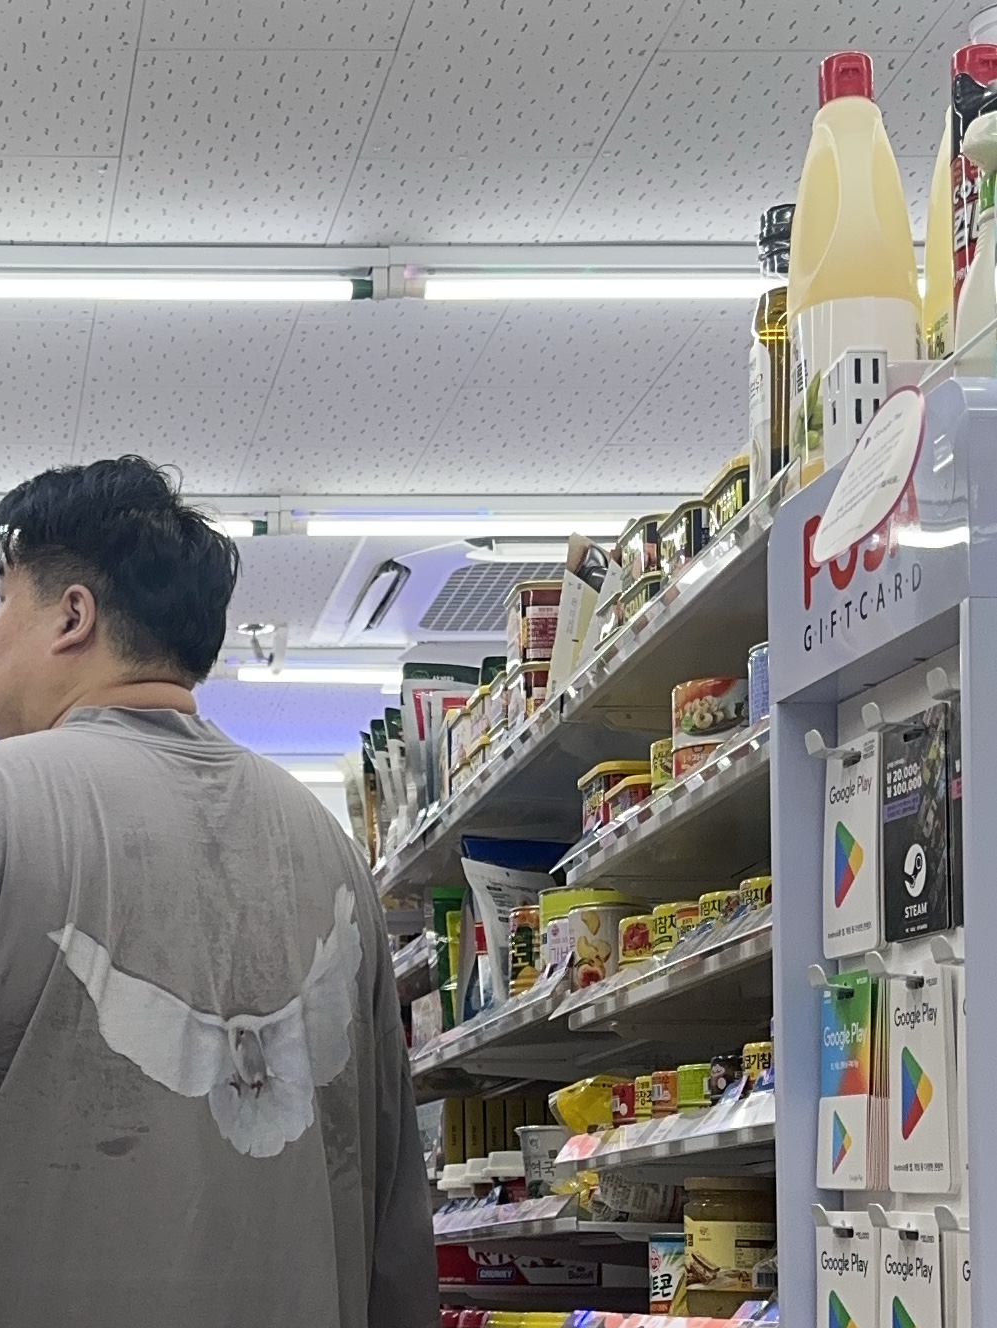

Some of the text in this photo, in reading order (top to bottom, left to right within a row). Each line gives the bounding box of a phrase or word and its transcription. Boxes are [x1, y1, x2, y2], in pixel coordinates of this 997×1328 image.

[829, 774, 873, 805] Google Play
[903, 901, 929, 920] STEAM
[894, 1002, 938, 1030] Google Play
[823, 1022, 866, 1050] Google Play
[820, 1250, 869, 1278] Google Play
[884, 1253, 934, 1284] Google Play
